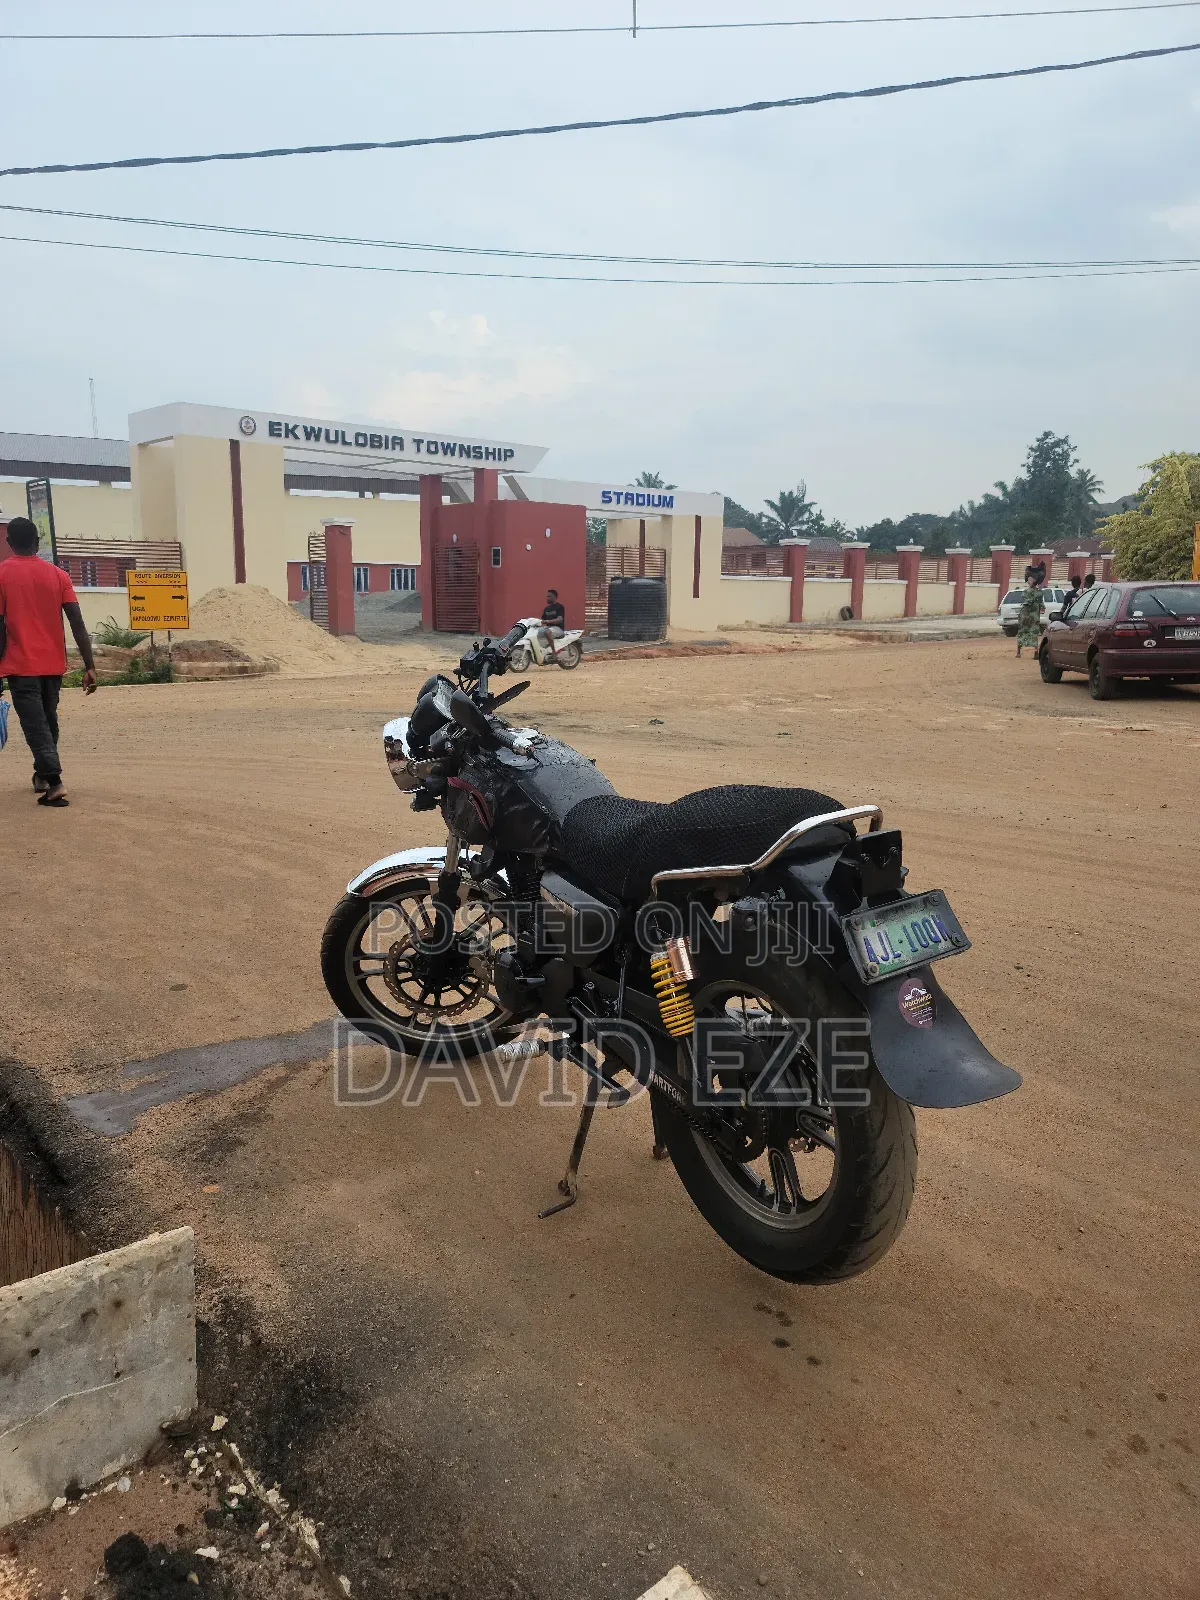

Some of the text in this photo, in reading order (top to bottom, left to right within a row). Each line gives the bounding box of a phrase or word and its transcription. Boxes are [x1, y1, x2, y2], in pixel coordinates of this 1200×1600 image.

[268, 420, 515, 462] EKWULOBIA TOWNSHIP
[601, 490, 675, 509] STADIUM
